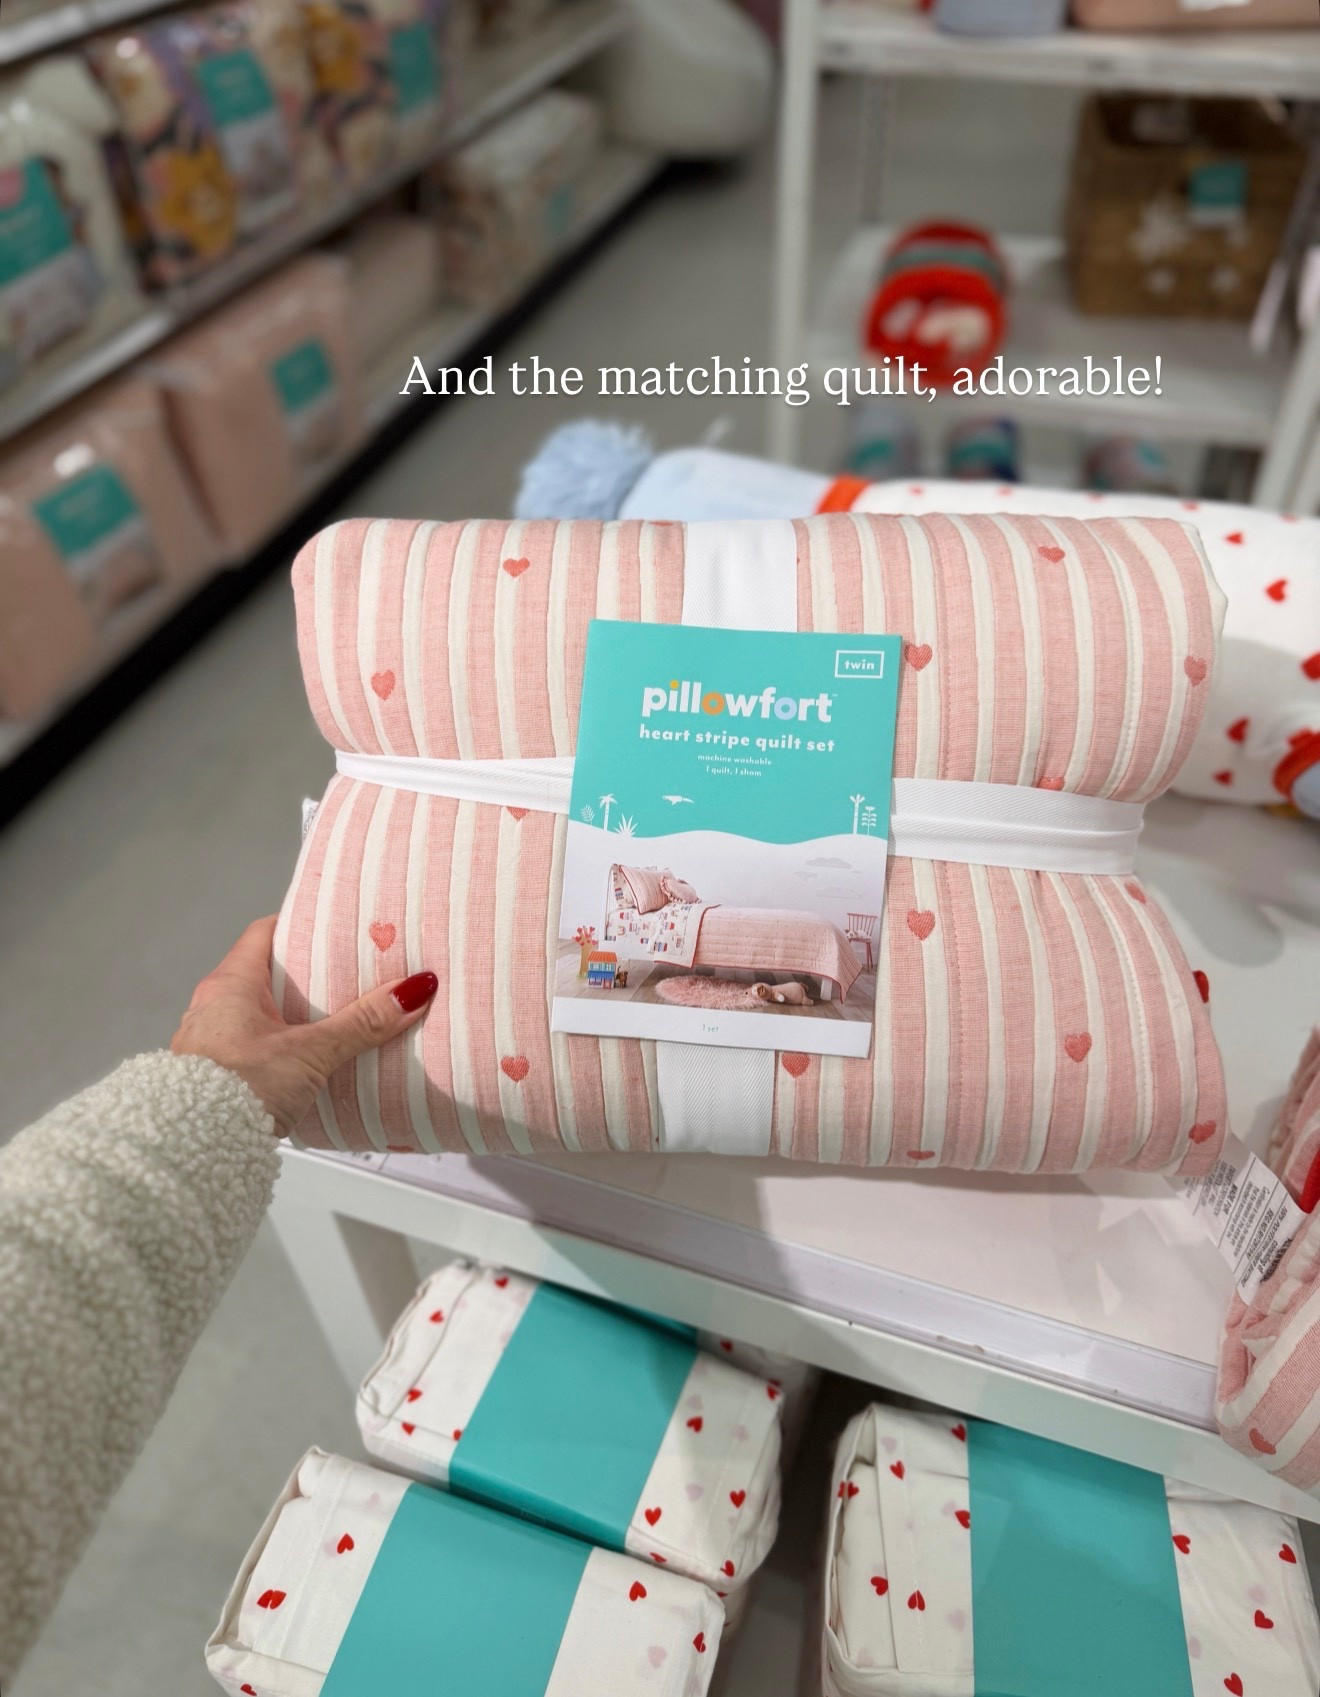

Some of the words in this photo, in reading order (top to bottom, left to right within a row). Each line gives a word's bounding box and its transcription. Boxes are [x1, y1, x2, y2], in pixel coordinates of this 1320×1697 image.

[845, 658, 876, 671] twin
[641, 679, 833, 724] pillowfort
[639, 723, 691, 742] heart
[695, 730, 750, 750] stripe
[756, 734, 802, 752] quilt
[806, 739, 836, 753] set
[697, 753, 732, 763] machine
[733, 756, 773, 766] washable
[711, 767, 733, 776] quilt,
[740, 768, 762, 777] sham
